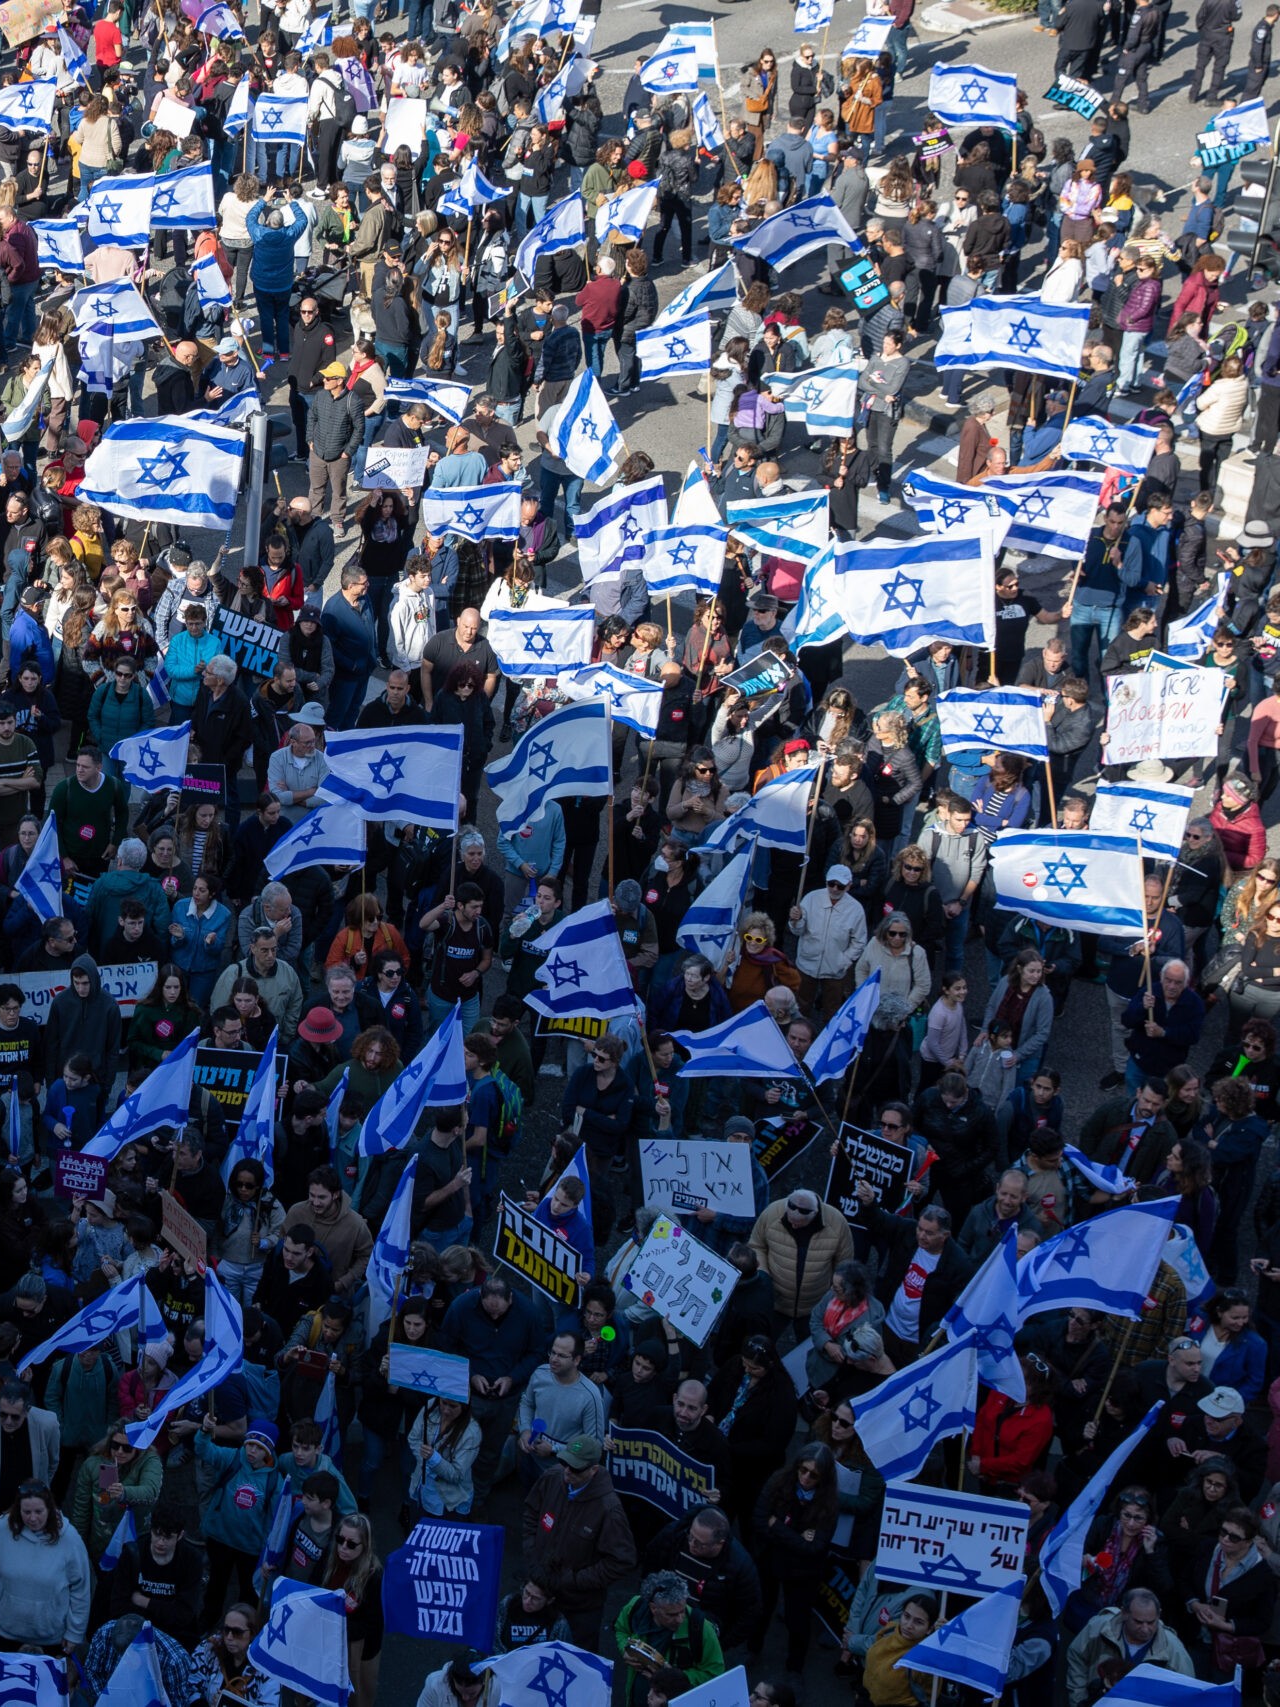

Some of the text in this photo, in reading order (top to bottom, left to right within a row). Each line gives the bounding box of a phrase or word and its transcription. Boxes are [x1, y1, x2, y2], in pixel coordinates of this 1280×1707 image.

[1046, 88, 1095, 119] בארצנו
[1058, 74, 1104, 108] חופשי
[219, 608, 283, 652] חופשי
[117, 964, 154, 977] הרופא
[669, 1141, 734, 1180] אין לי
[845, 1135, 904, 1173] ממשלת
[648, 1178, 743, 1200] ארץ אחרת
[504, 1200, 576, 1280] חובה
[504, 1228, 576, 1305] להתנגד
[671, 1239, 725, 1284] יש לי
[643, 1262, 708, 1327] חלום
[612, 1459, 678, 1503] אקדמיה
[613, 1438, 707, 1492] בלי דמוקרטיה
[406, 1523, 481, 1554] דיקטטורה
[886, 1507, 1024, 1544] זוהי שקיעתה
[880, 1533, 1019, 1571] של הזריחה
[413, 1580, 467, 1607] הנפש
